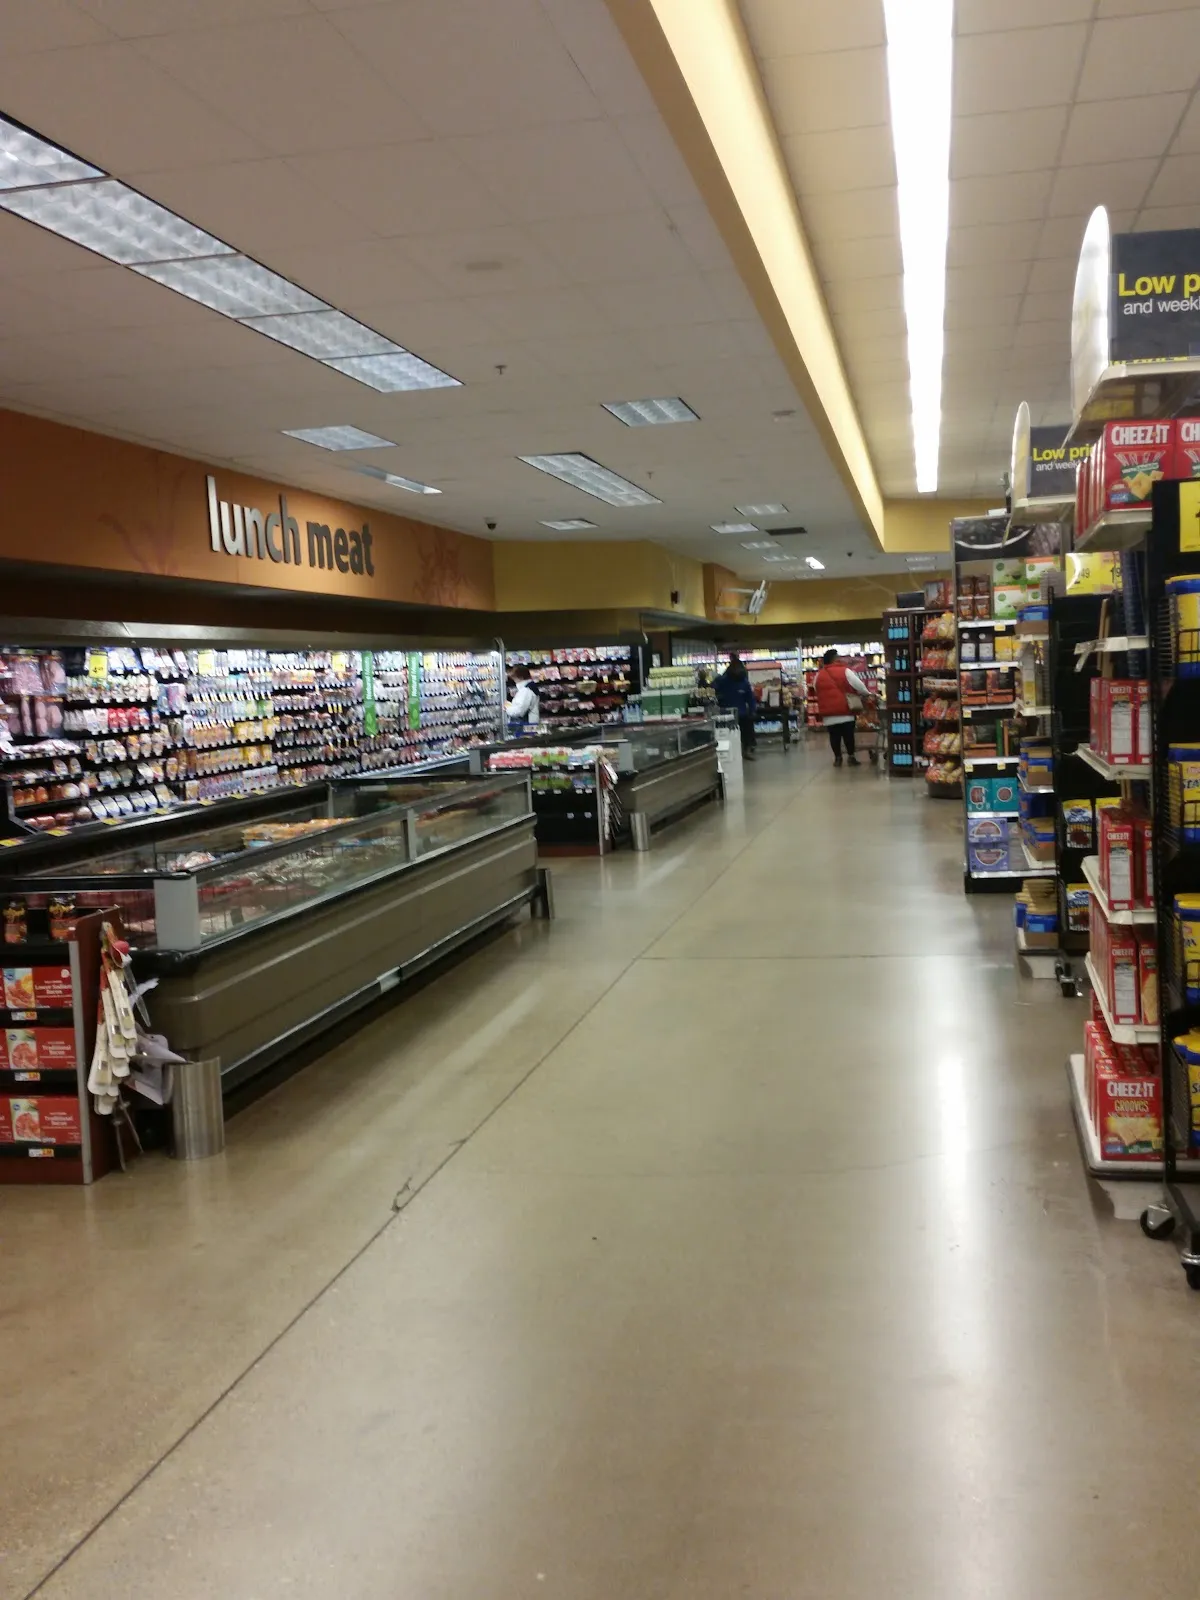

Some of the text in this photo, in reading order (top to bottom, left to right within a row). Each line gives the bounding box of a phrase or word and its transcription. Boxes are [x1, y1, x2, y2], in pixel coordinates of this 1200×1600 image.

[1118, 272, 1176, 297] Low
[1123, 298, 1153, 315] and
[1032, 448, 1066, 461] Low
[1036, 462, 1053, 471] and
[206, 474, 375, 578] lunch meat
